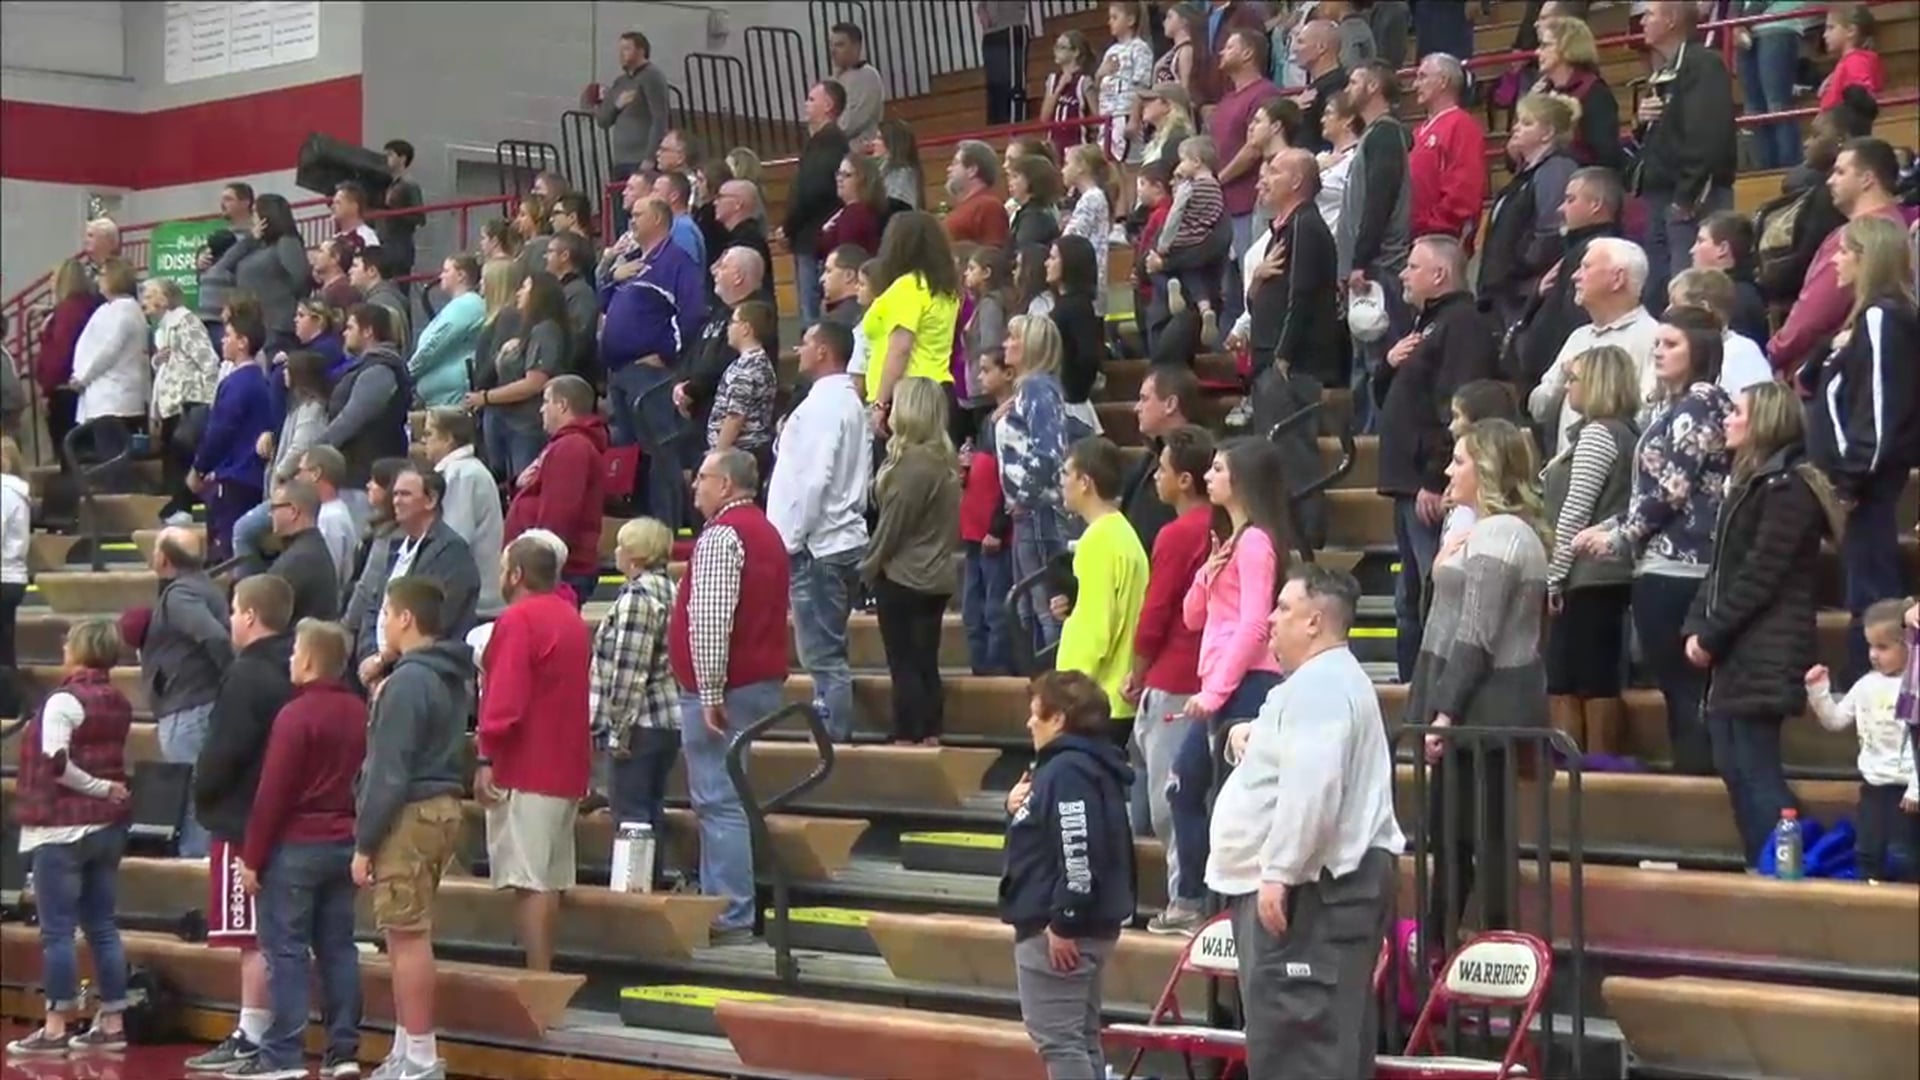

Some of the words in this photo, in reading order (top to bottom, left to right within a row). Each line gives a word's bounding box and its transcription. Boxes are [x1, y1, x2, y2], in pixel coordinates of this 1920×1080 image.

[1058, 800, 1091, 894] BULLDOG
[1776, 845, 1788, 861] G
[1202, 936, 1238, 958] WAR
[1459, 961, 1530, 985] WARRIORS
